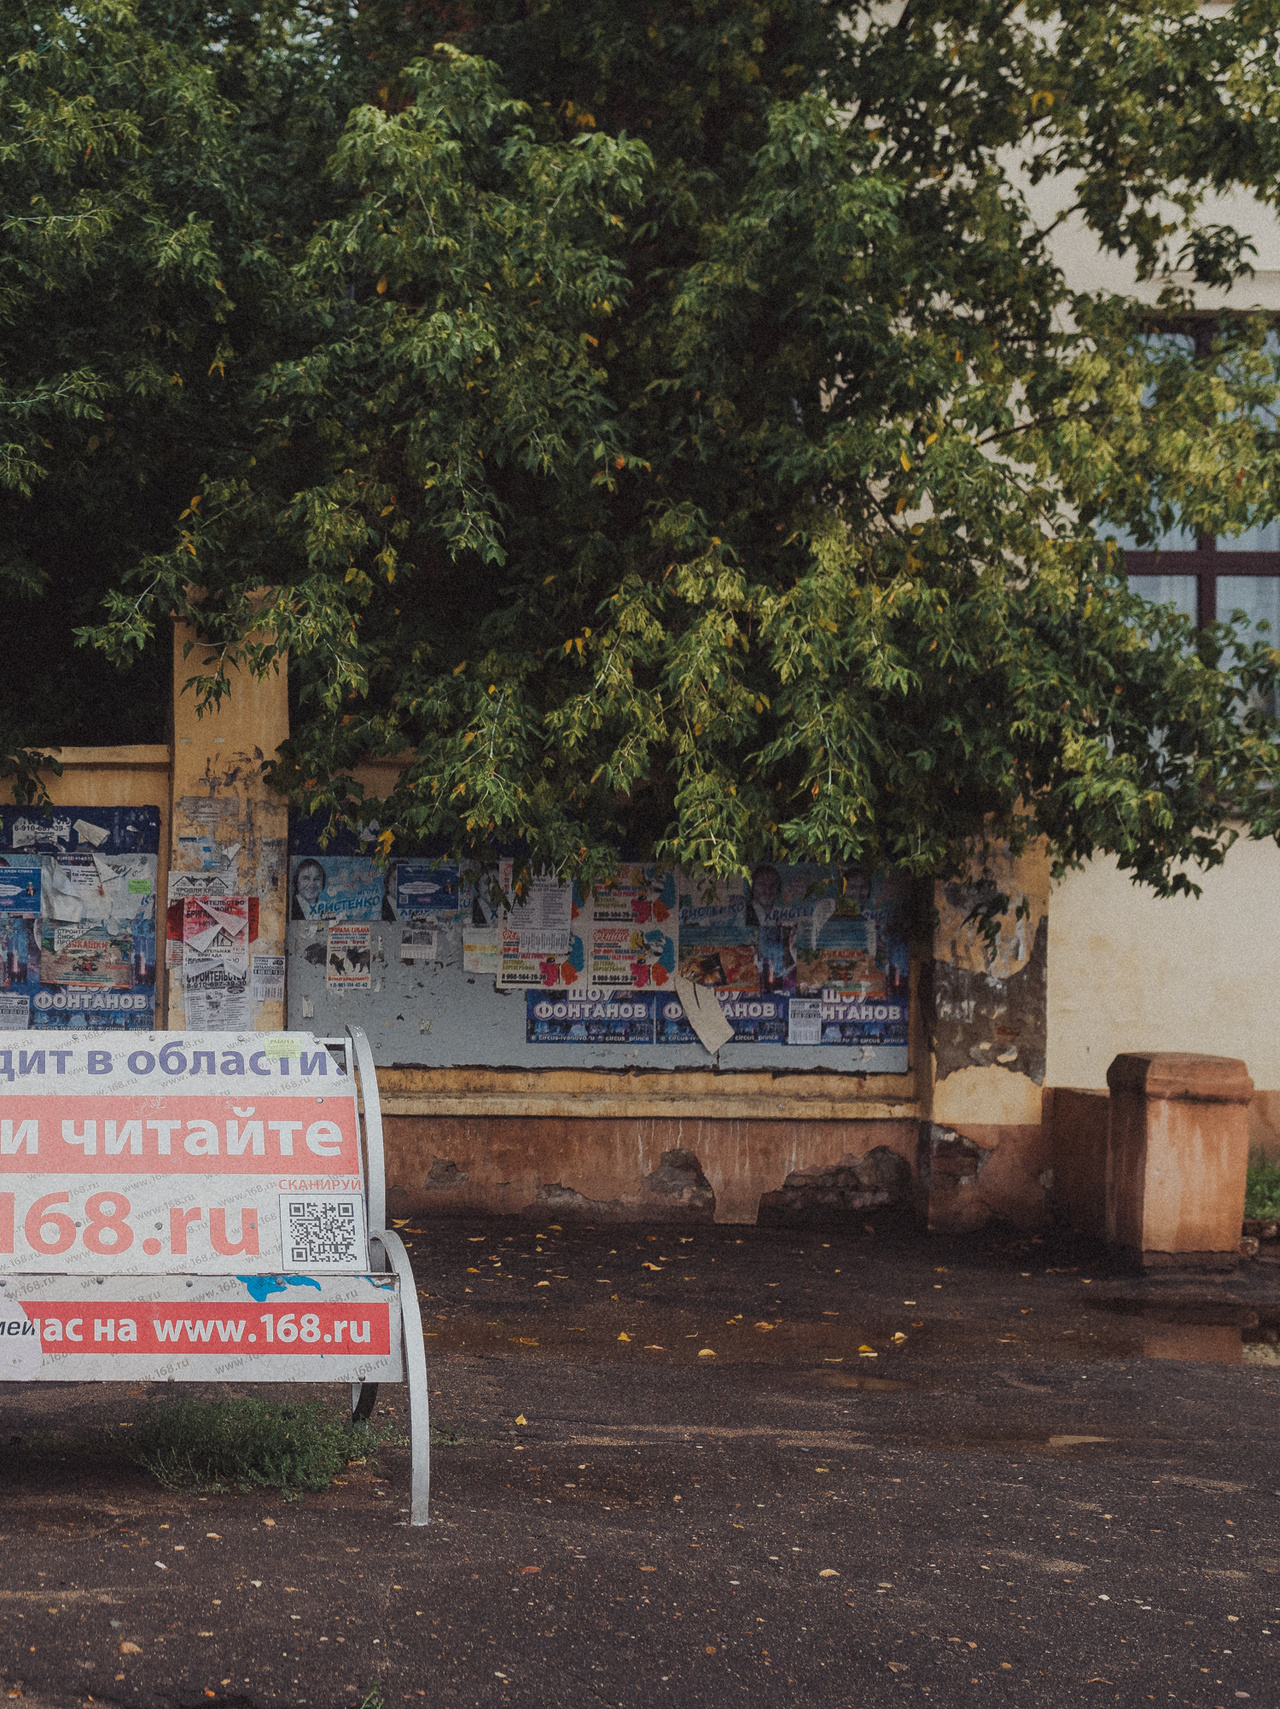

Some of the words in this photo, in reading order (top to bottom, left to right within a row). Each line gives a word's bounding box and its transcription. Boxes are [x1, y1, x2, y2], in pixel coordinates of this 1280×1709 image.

[309, 894, 381, 915] ХРИСТЕНКО
[34, 991, 148, 1011] ФОНТАНОВ
[567, 989, 614, 1001] ШОУ
[534, 1001, 648, 1020] ФОНТАНОВ
[663, 1001, 778, 1020] ФАНОВ
[821, 1004, 903, 1022] НТАНОВ
[86, 1050, 113, 1075] в
[0, 1119, 39, 1155] и
[61, 1106, 343, 1157] читайте
[217, 1180, 278, 1208] www.168.ru
[277, 1177, 362, 1191] СКАНИРУЙ
[134, 1193, 196, 1221] www.168.ru
[93, 1318, 138, 1343] на
[152, 1313, 371, 1344] www.168.ru
